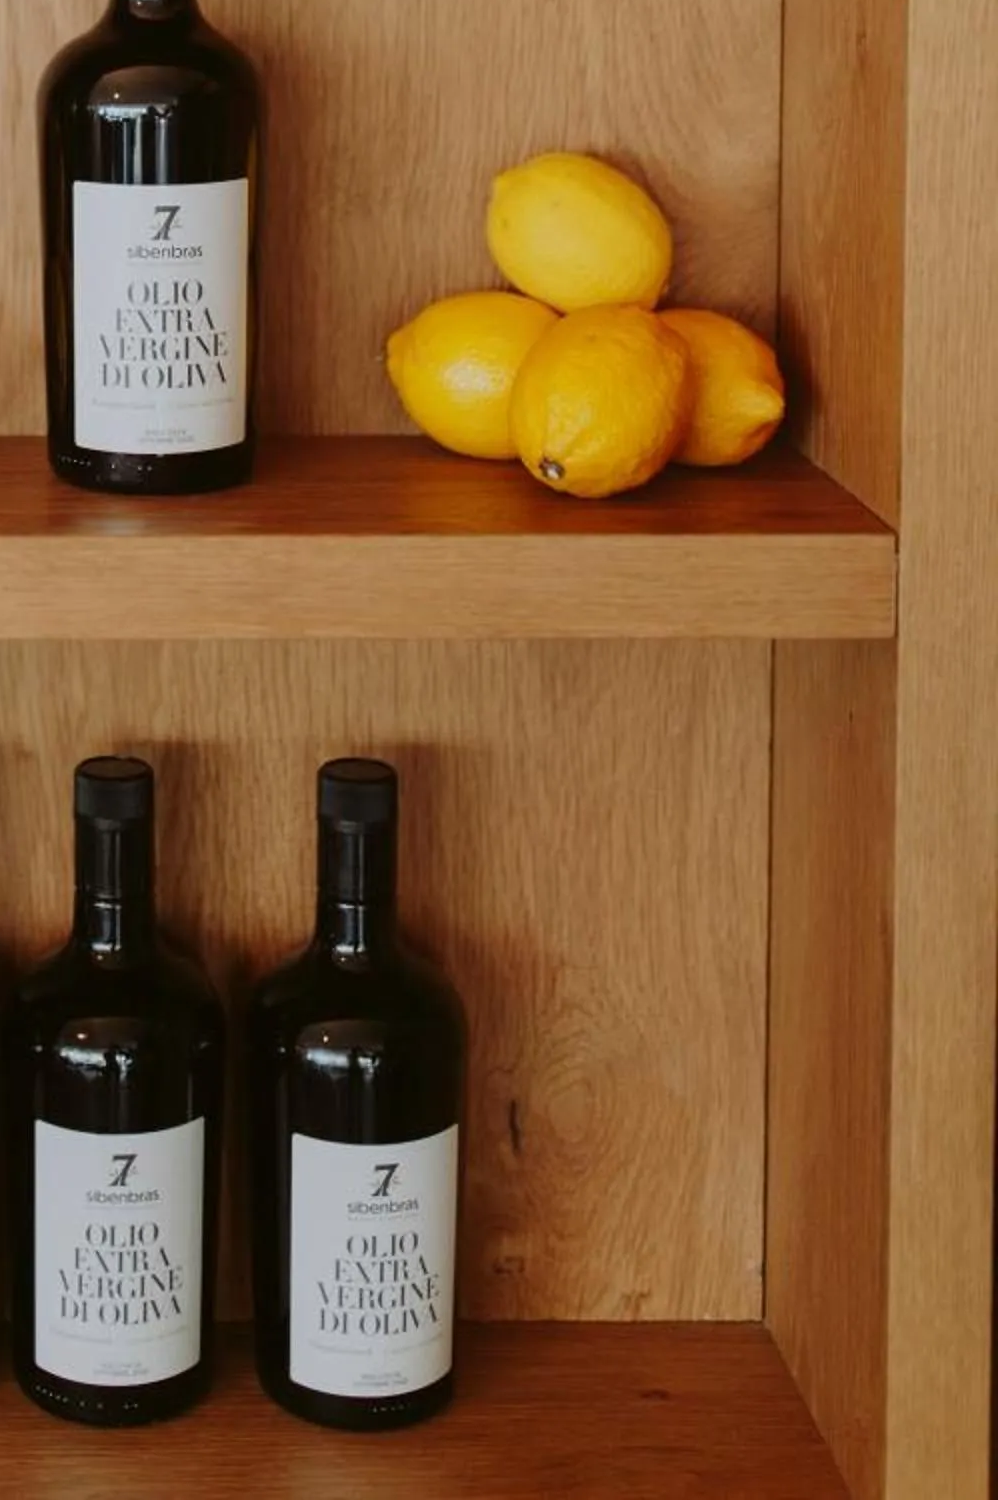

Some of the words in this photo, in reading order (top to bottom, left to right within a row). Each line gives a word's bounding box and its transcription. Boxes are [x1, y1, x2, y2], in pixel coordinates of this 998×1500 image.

[127, 245, 203, 259] sibenbras
[127, 281, 204, 305] OLIO
[115, 307, 216, 333] EXTRA
[100, 331, 229, 361] VERGINE
[141, 361, 227, 389] OLIVA
[85, 1189, 160, 1203] sibenbras
[347, 1198, 419, 1214] sibenbras
[85, 1222, 160, 1248] OLIO
[346, 1231, 419, 1258] OLIO
[74, 1247, 170, 1273] EXTRA
[335, 1254, 429, 1284] EXTRA
[59, 1266, 184, 1299] VERGINE
[317, 1273, 440, 1310] VERGINE
[98, 1295, 182, 1326] OLIVA
[358, 1302, 439, 1336] OLIVA
